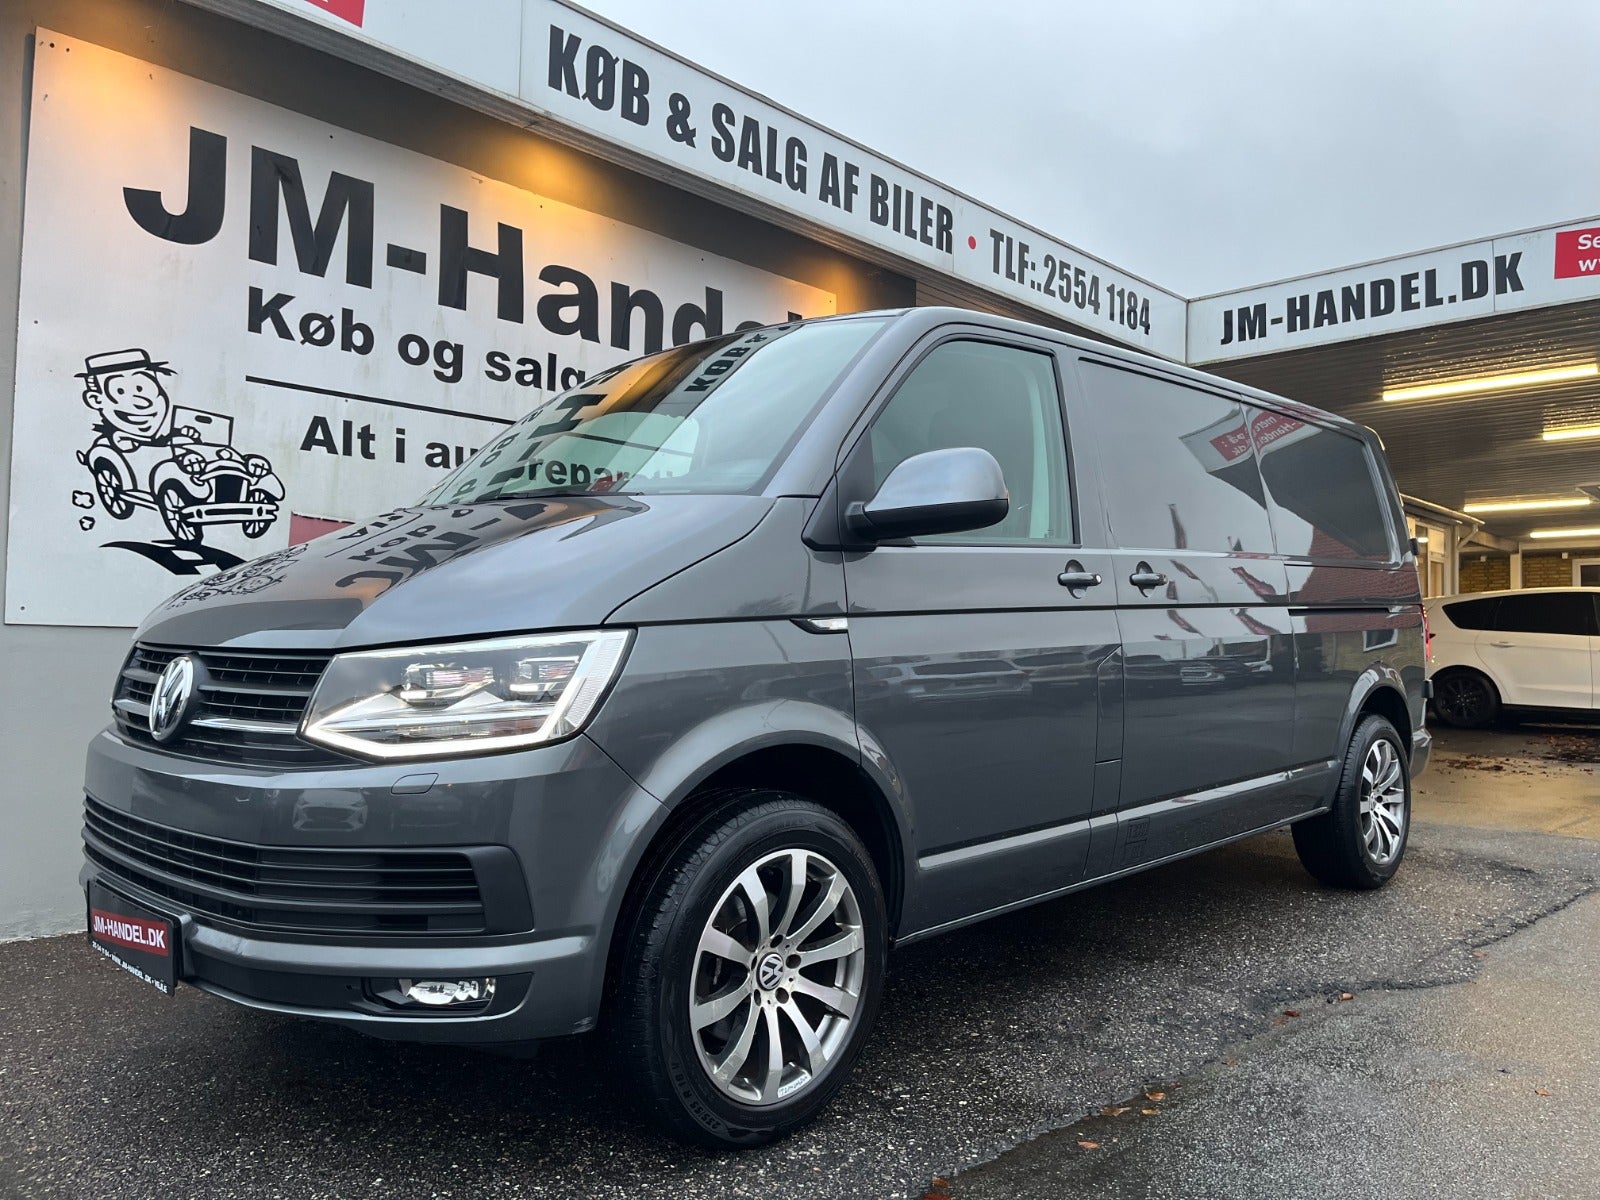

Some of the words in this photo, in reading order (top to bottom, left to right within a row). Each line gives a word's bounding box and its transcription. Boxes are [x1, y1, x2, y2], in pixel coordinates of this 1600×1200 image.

[547, 24, 650, 127] KØB
[666, 92, 697, 149] &
[711, 102, 808, 194] SALG
[818, 151, 860, 214] AF
[869, 172, 954, 255] BILER
[1106, 283, 1151, 336] 1184
[122, 125, 803, 354] JM-Hand
[247, 286, 375, 358] Køb
[398, 333, 464, 384] og
[1219, 251, 1525, 346] JM-HANDEL.DK
[300, 415, 376, 461] Alt
[396, 428, 407, 464] i
[93, 915, 166, 949] JM-HANDEL.DK
